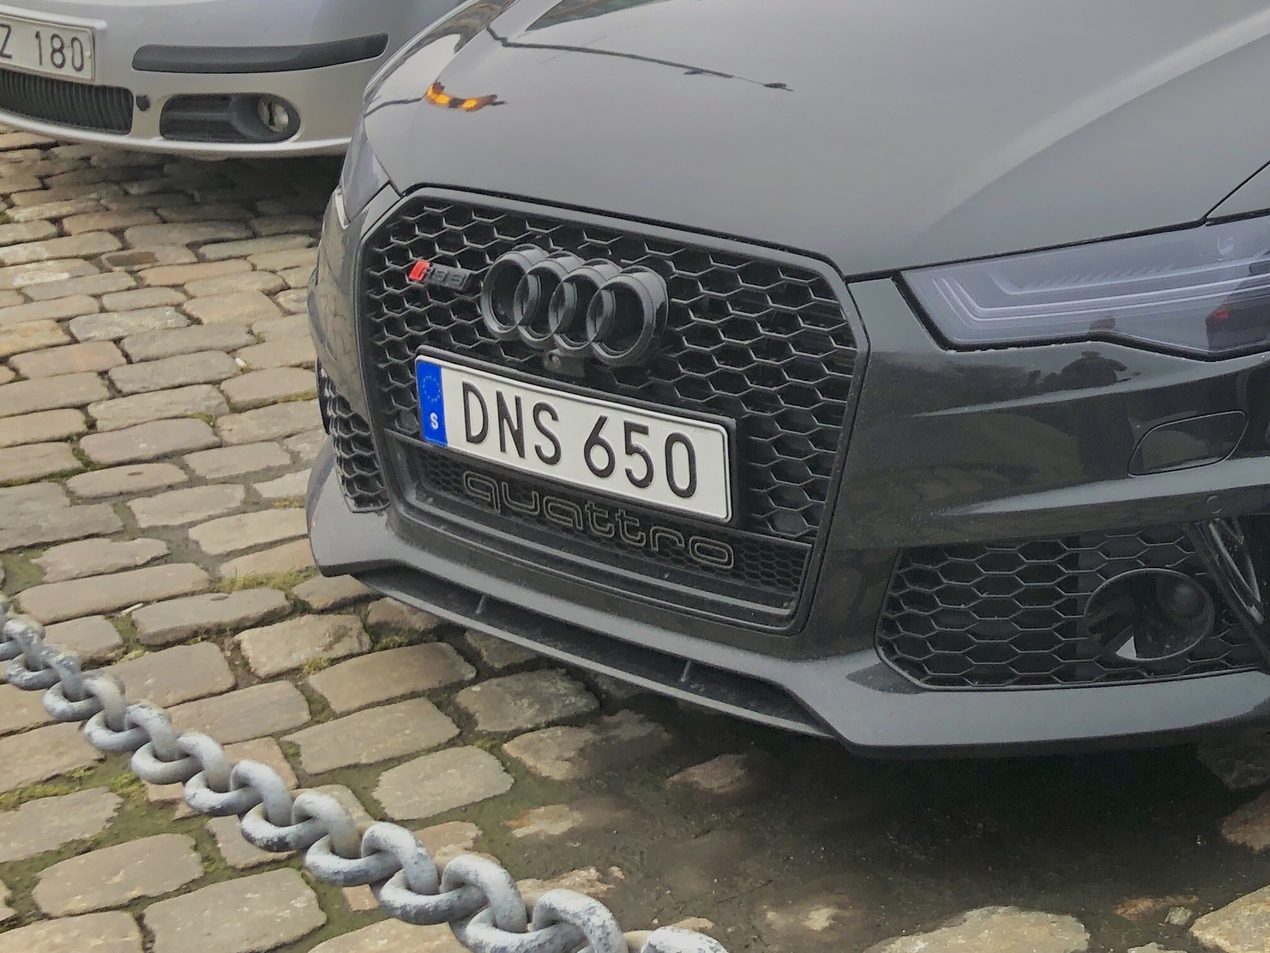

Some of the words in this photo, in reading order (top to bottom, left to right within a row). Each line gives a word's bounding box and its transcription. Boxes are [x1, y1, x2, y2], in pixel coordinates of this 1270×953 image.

[34, 30, 84, 72] 180
[430, 413, 439, 430] S
[462, 380, 562, 466] DNS
[583, 414, 697, 499] 650
[462, 470, 735, 569] quattro
